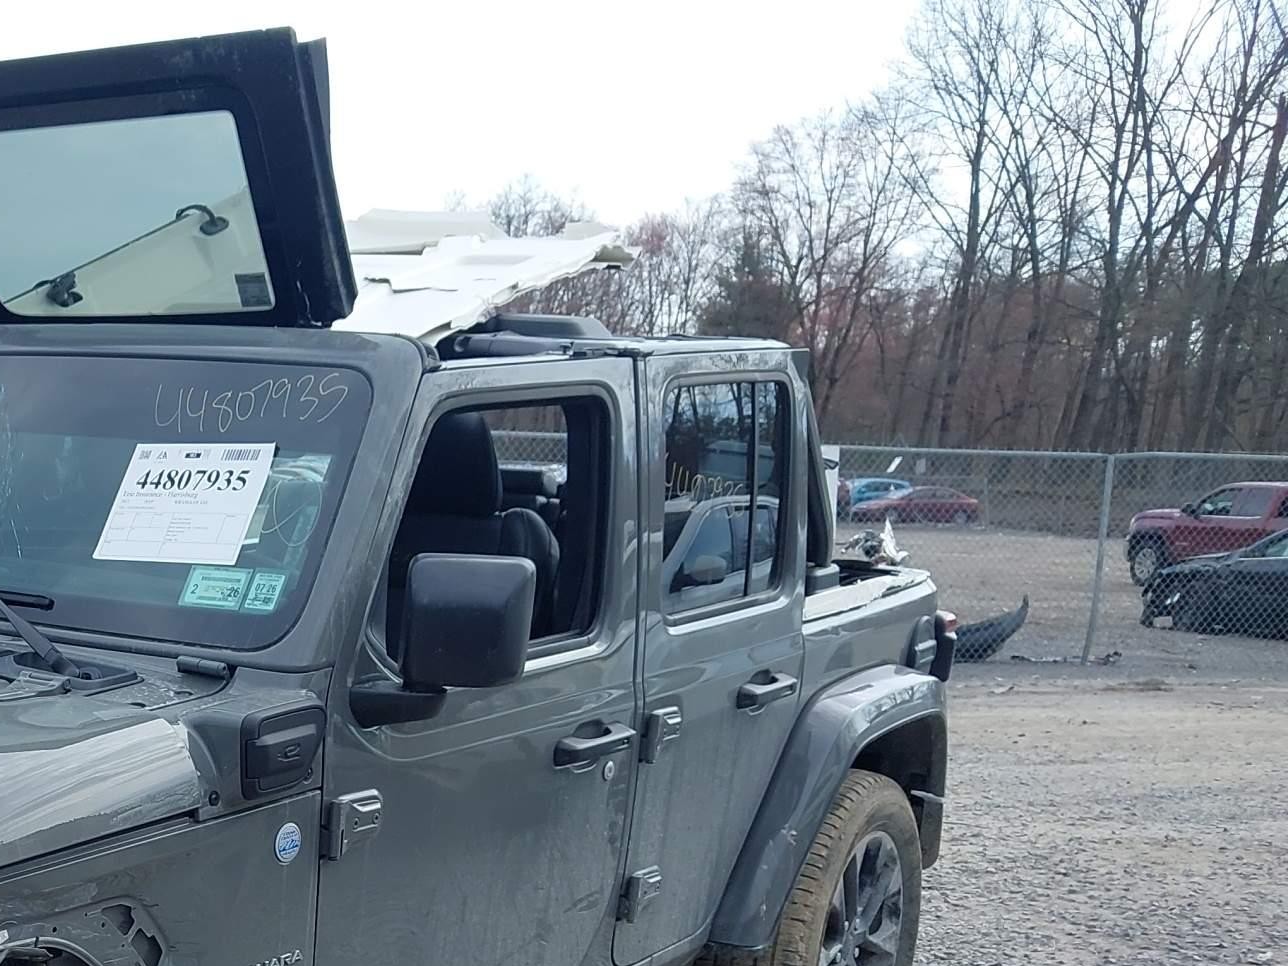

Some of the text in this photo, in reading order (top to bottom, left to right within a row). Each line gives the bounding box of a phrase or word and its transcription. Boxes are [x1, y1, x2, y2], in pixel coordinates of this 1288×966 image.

[154, 373, 349, 432] 44807935
[136, 469, 251, 491] 44807935
[190, 583, 199, 594] 2
[255, 583, 265, 593] 07
